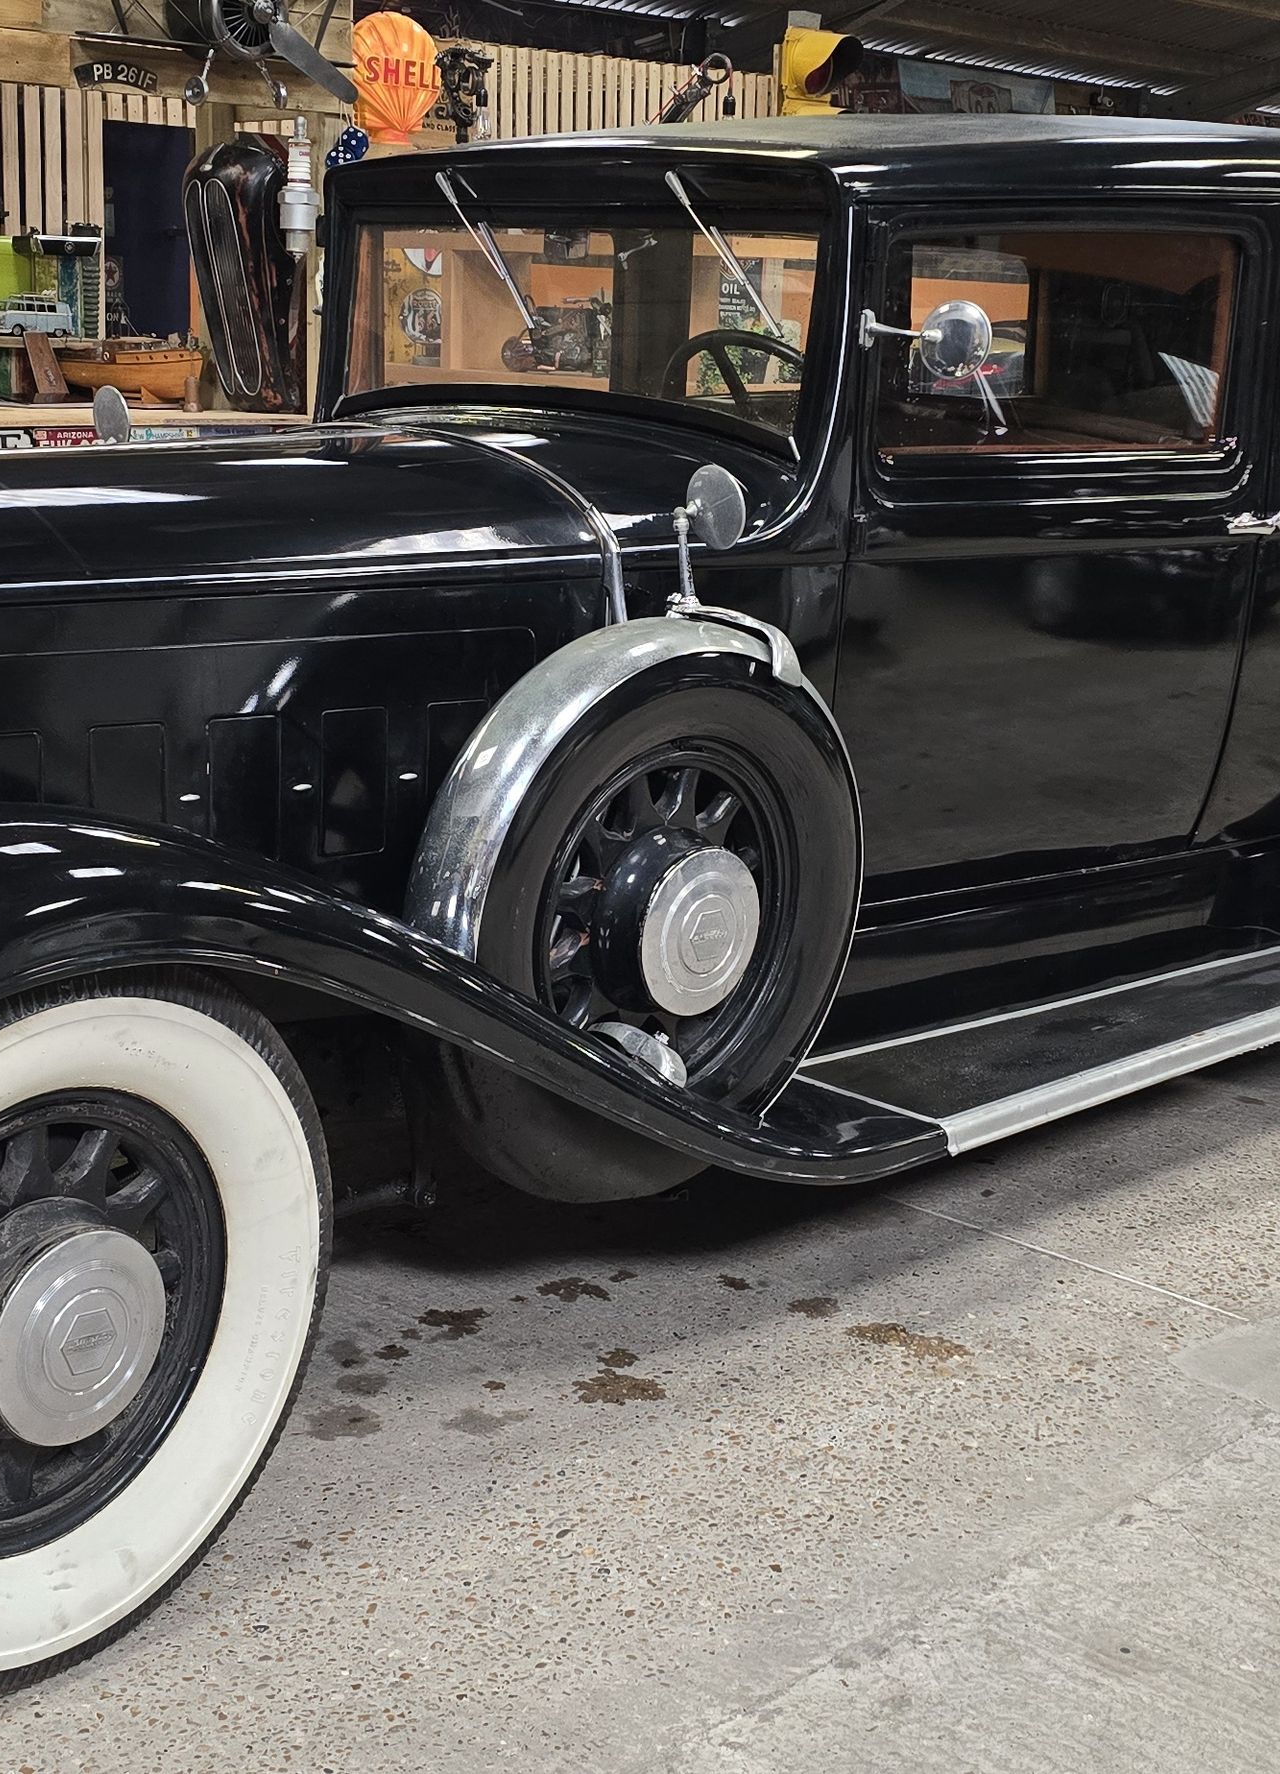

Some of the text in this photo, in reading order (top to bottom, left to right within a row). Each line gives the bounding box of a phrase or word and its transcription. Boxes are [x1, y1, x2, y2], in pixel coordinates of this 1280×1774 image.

[93, 63, 113, 81] PB
[366, 56, 440, 91] SHELL
[721, 283, 741, 295] OIL
[56, 431, 94, 440] ARIZONA
